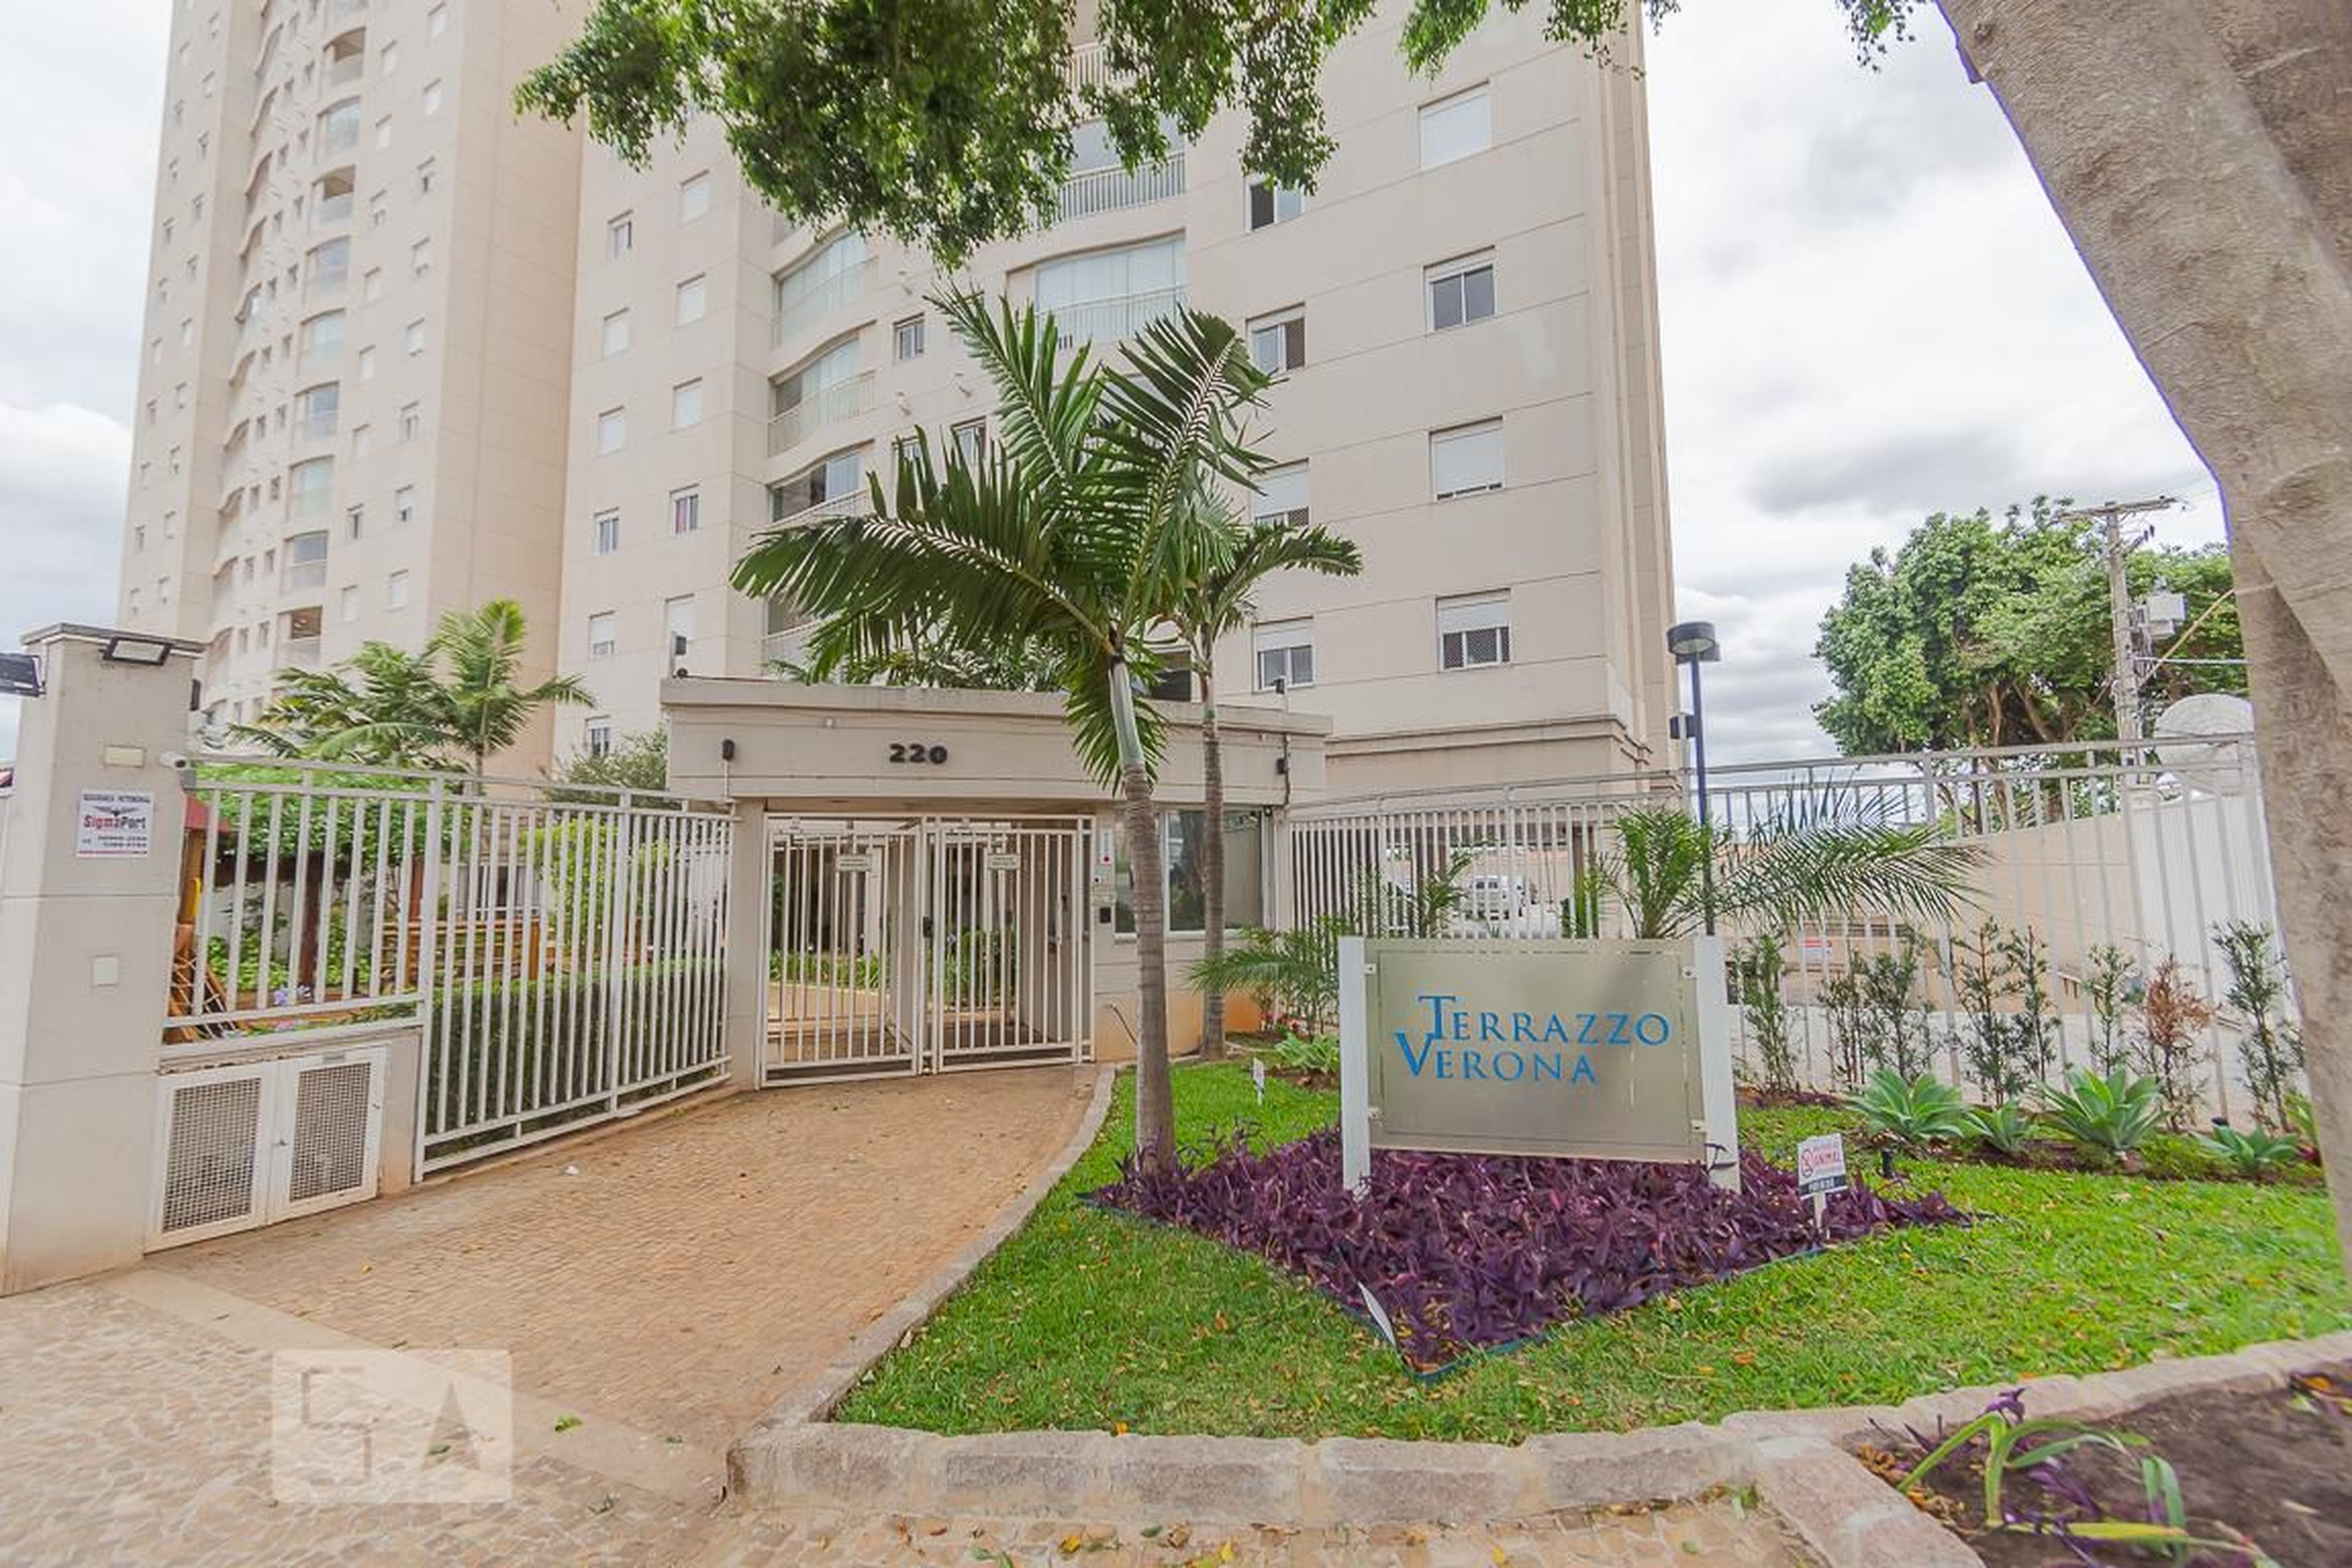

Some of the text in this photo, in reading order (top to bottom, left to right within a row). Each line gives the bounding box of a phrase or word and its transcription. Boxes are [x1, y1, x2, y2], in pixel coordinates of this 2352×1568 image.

[889, 743, 948, 764] 220
[1418, 995, 1670, 1046] TERRAZZO
[1395, 1031, 1597, 1084] VERONA
